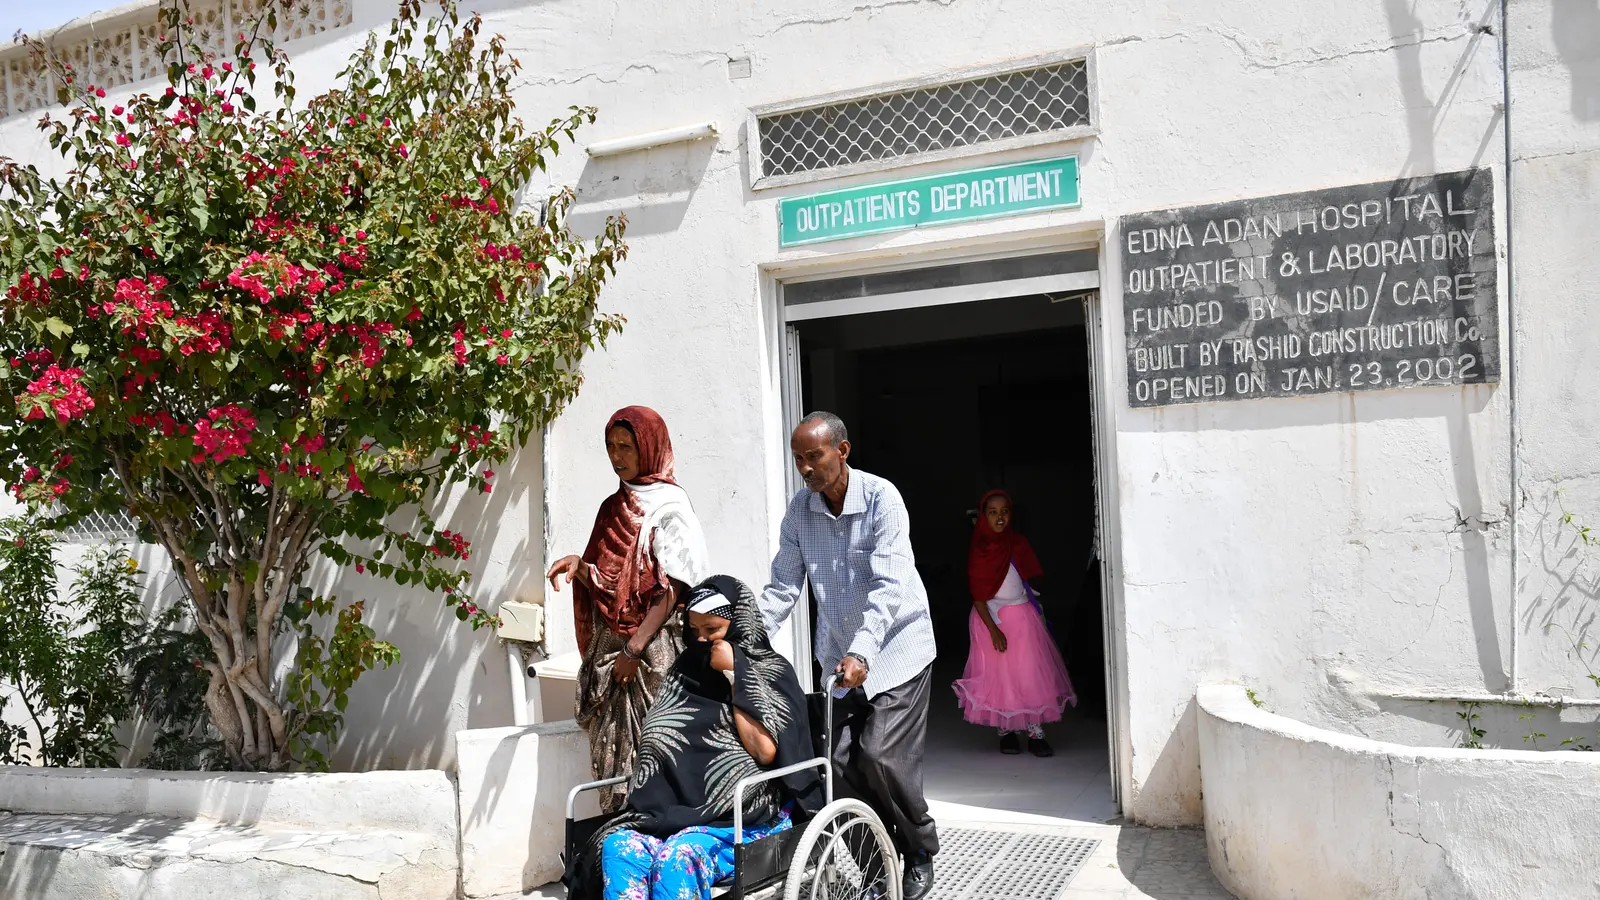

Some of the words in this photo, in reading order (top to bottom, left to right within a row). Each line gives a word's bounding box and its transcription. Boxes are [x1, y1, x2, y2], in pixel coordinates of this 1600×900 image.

[796, 189, 920, 233] OUTPATIENTS
[930, 168, 1063, 213] DEPARTMENT
[1128, 223, 1194, 254] EDNA
[1202, 213, 1282, 247] ADAN
[1297, 189, 1476, 235] HOSPITAL
[1129, 253, 1272, 293] OUTPATIENT
[1279, 251, 1302, 277] &
[1309, 228, 1478, 274] LABORATORY
[1132, 300, 1223, 333] FUNDED
[1251, 297, 1278, 321] BY
[1135, 343, 1189, 373] BUILT
[1200, 339, 1224, 367] BY
[1233, 333, 1301, 365] RASHID
[1309, 317, 1449, 357] CONSTRUCTION
[1455, 316, 1486, 343] Co.
[1135, 375, 1226, 402] OPENED
[1235, 371, 1266, 395] ON
[1281, 365, 1341, 391] JAN.
